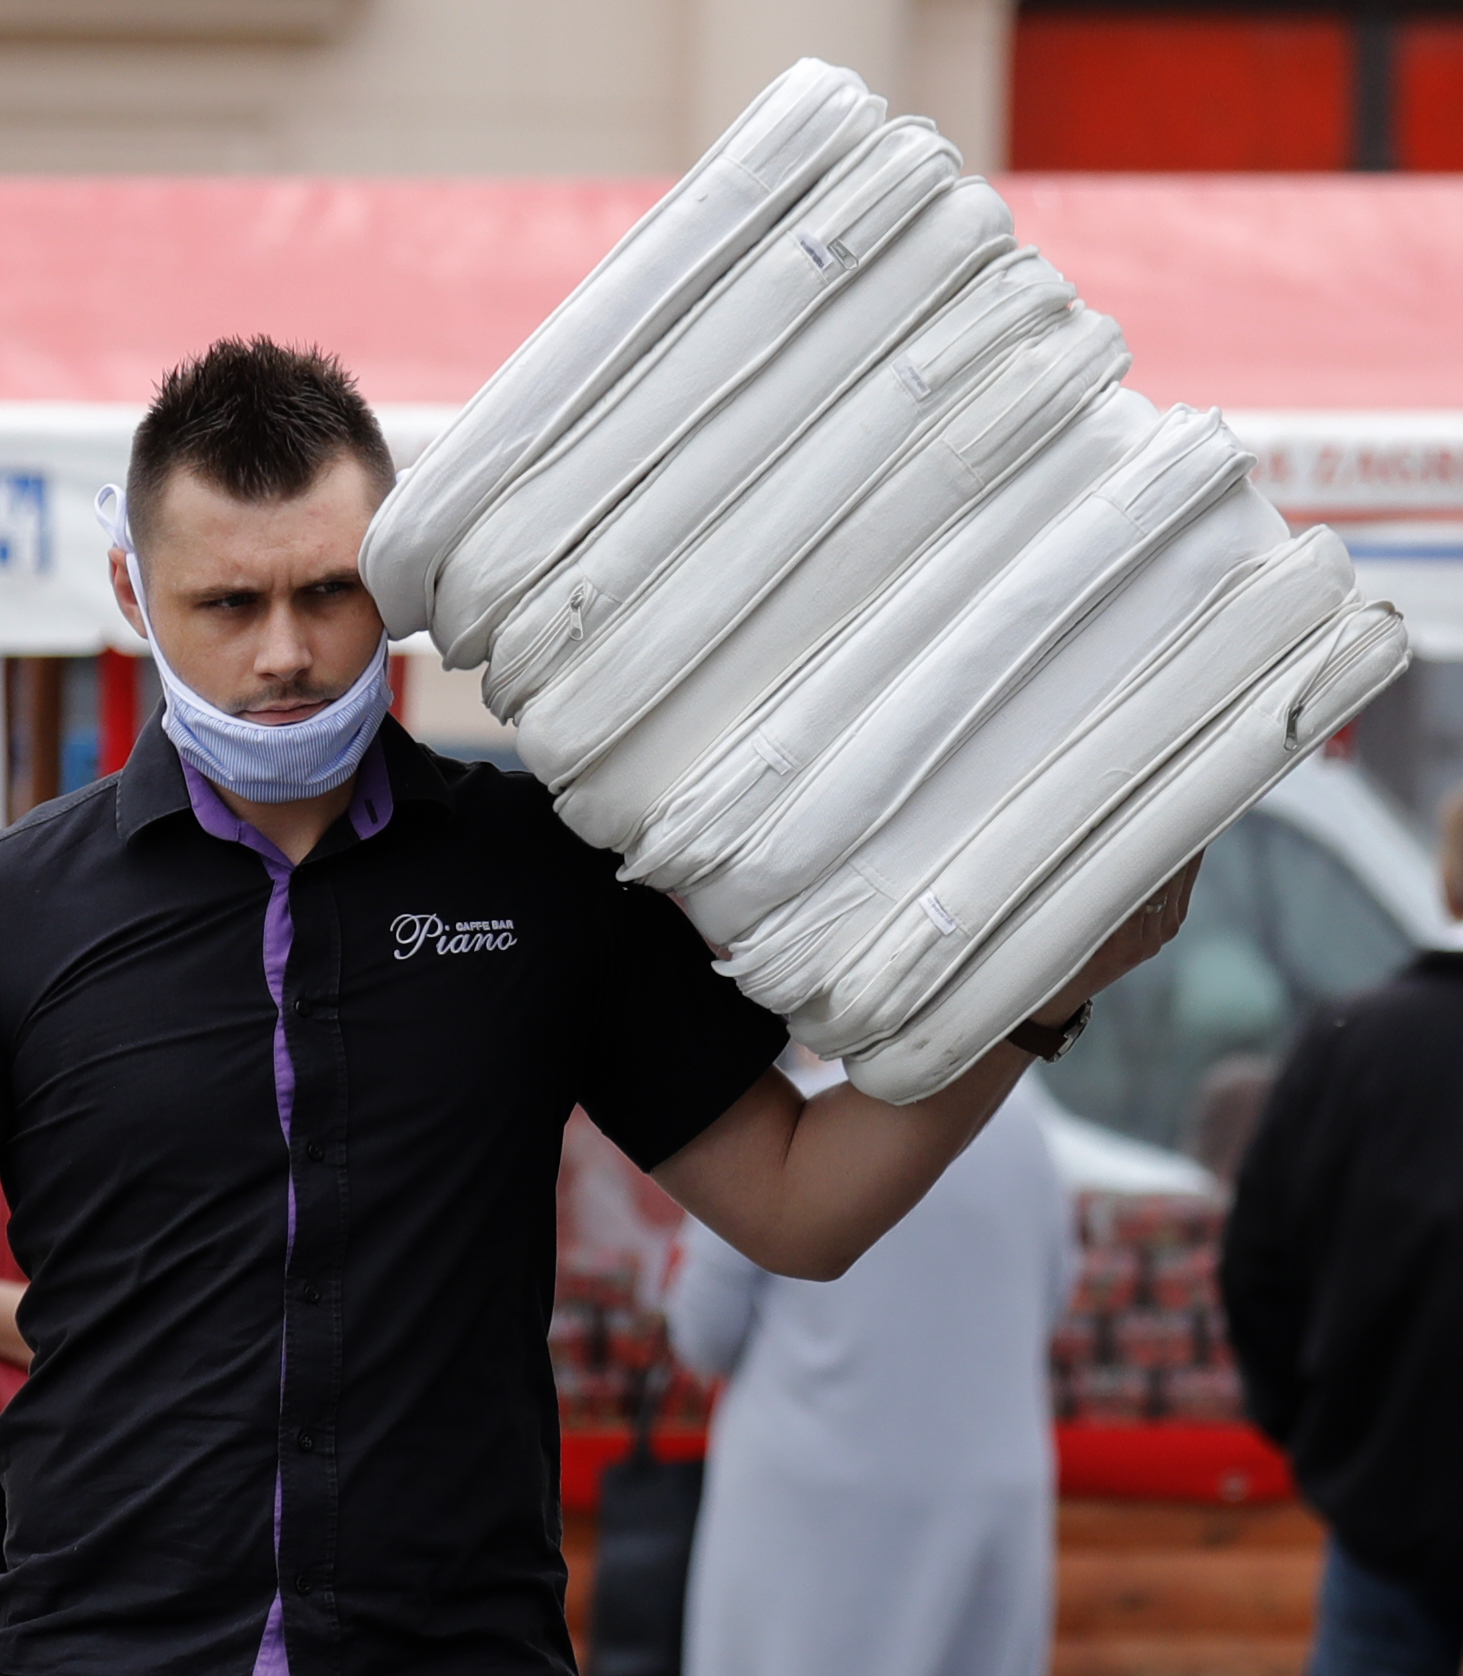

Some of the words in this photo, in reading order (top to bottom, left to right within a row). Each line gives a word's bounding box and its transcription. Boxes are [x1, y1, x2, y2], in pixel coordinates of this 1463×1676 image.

[389, 913, 518, 960] Piano
[455, 921, 491, 932] CAFFE
[491, 919, 514, 930] BAR
